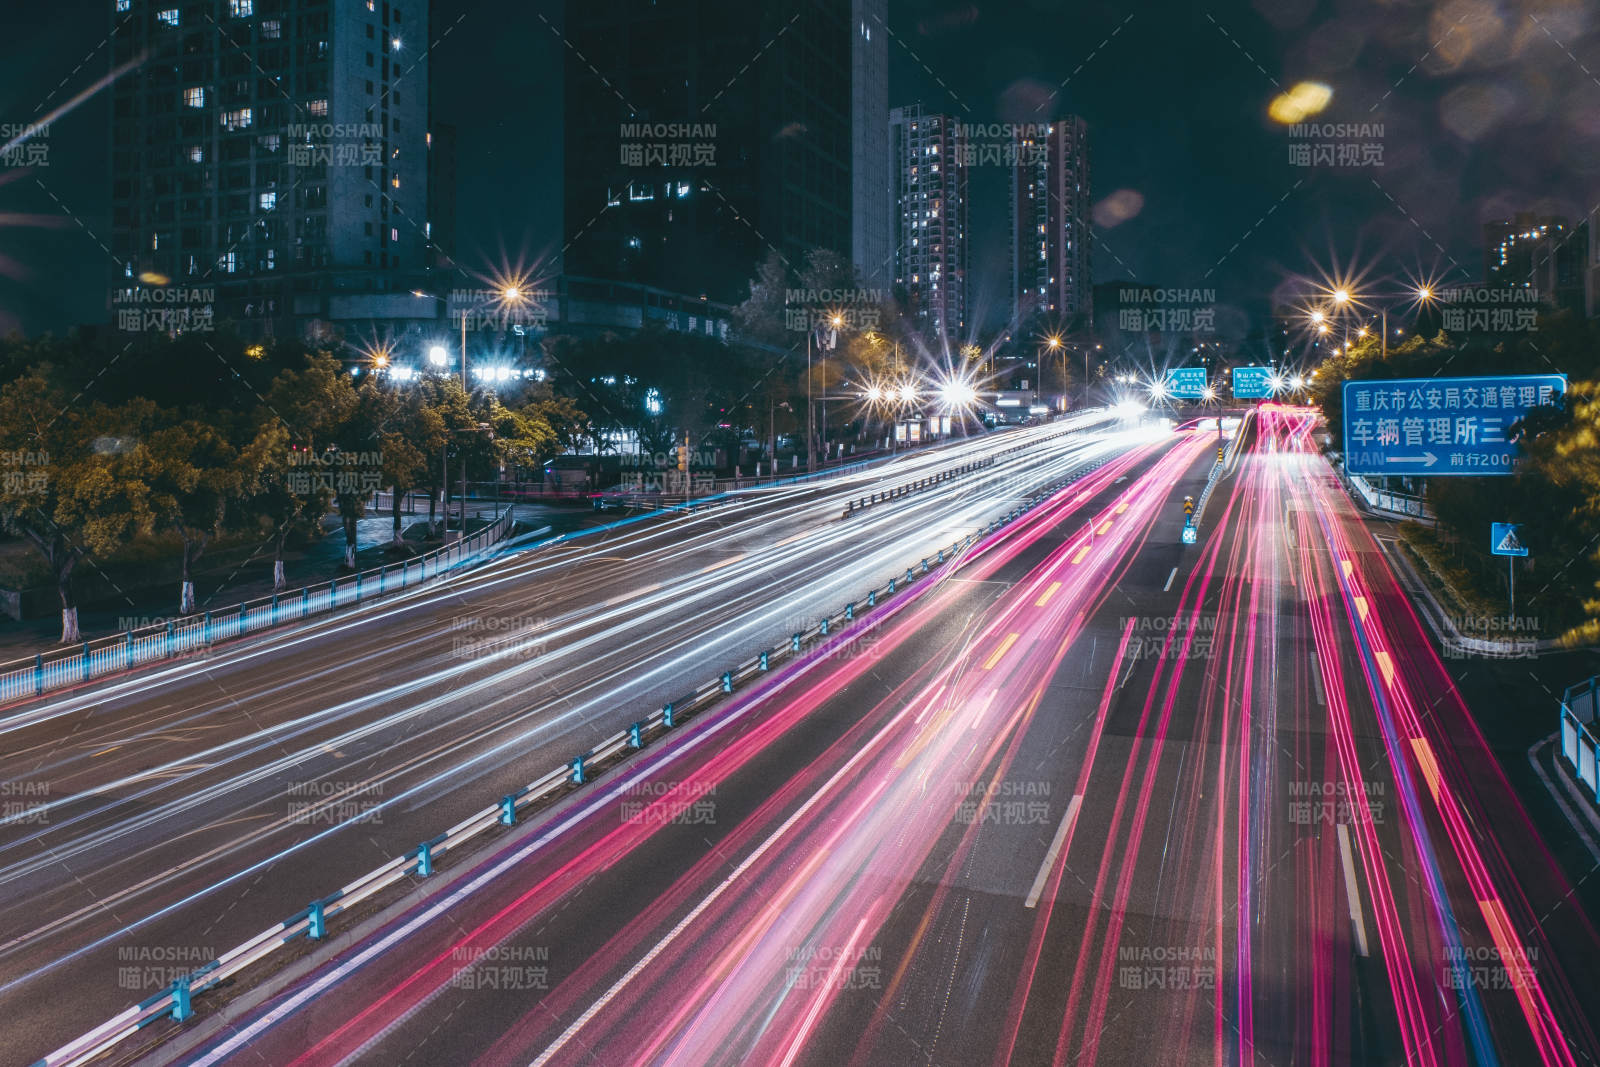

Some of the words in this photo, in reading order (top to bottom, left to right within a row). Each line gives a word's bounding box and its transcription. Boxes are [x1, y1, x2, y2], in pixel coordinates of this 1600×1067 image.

[1355, 385, 1554, 411] 重庆市公安局交通管理局
